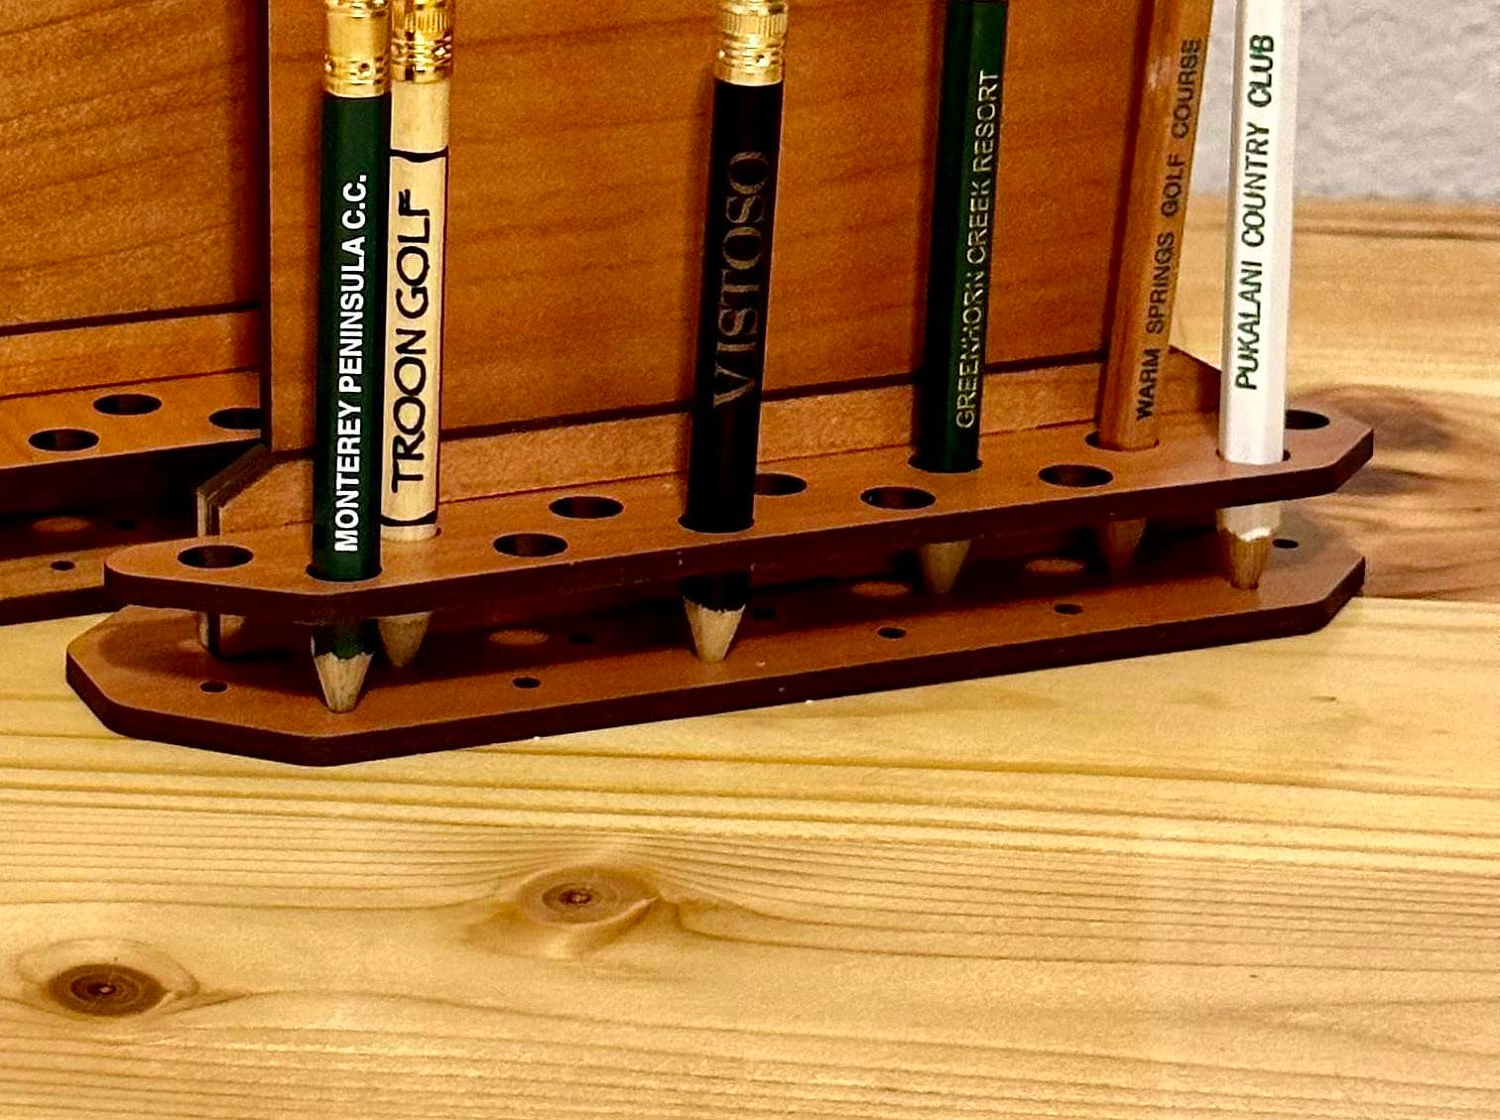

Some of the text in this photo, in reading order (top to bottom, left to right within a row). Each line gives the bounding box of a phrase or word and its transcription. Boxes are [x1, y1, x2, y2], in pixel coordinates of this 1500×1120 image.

[334, 174, 368, 551] MONTEREY PENINSULA C.C.
[392, 188, 431, 493] TROON GOLF
[713, 151, 769, 409] VISTOSO
[956, 70, 999, 429] GREENHORN CREEK RESORT
[1136, 38, 1201, 422] WARM SPRINGS GOLF COURSE
[1235, 34, 1275, 390] PUKALANI COUNTRY CLUB
